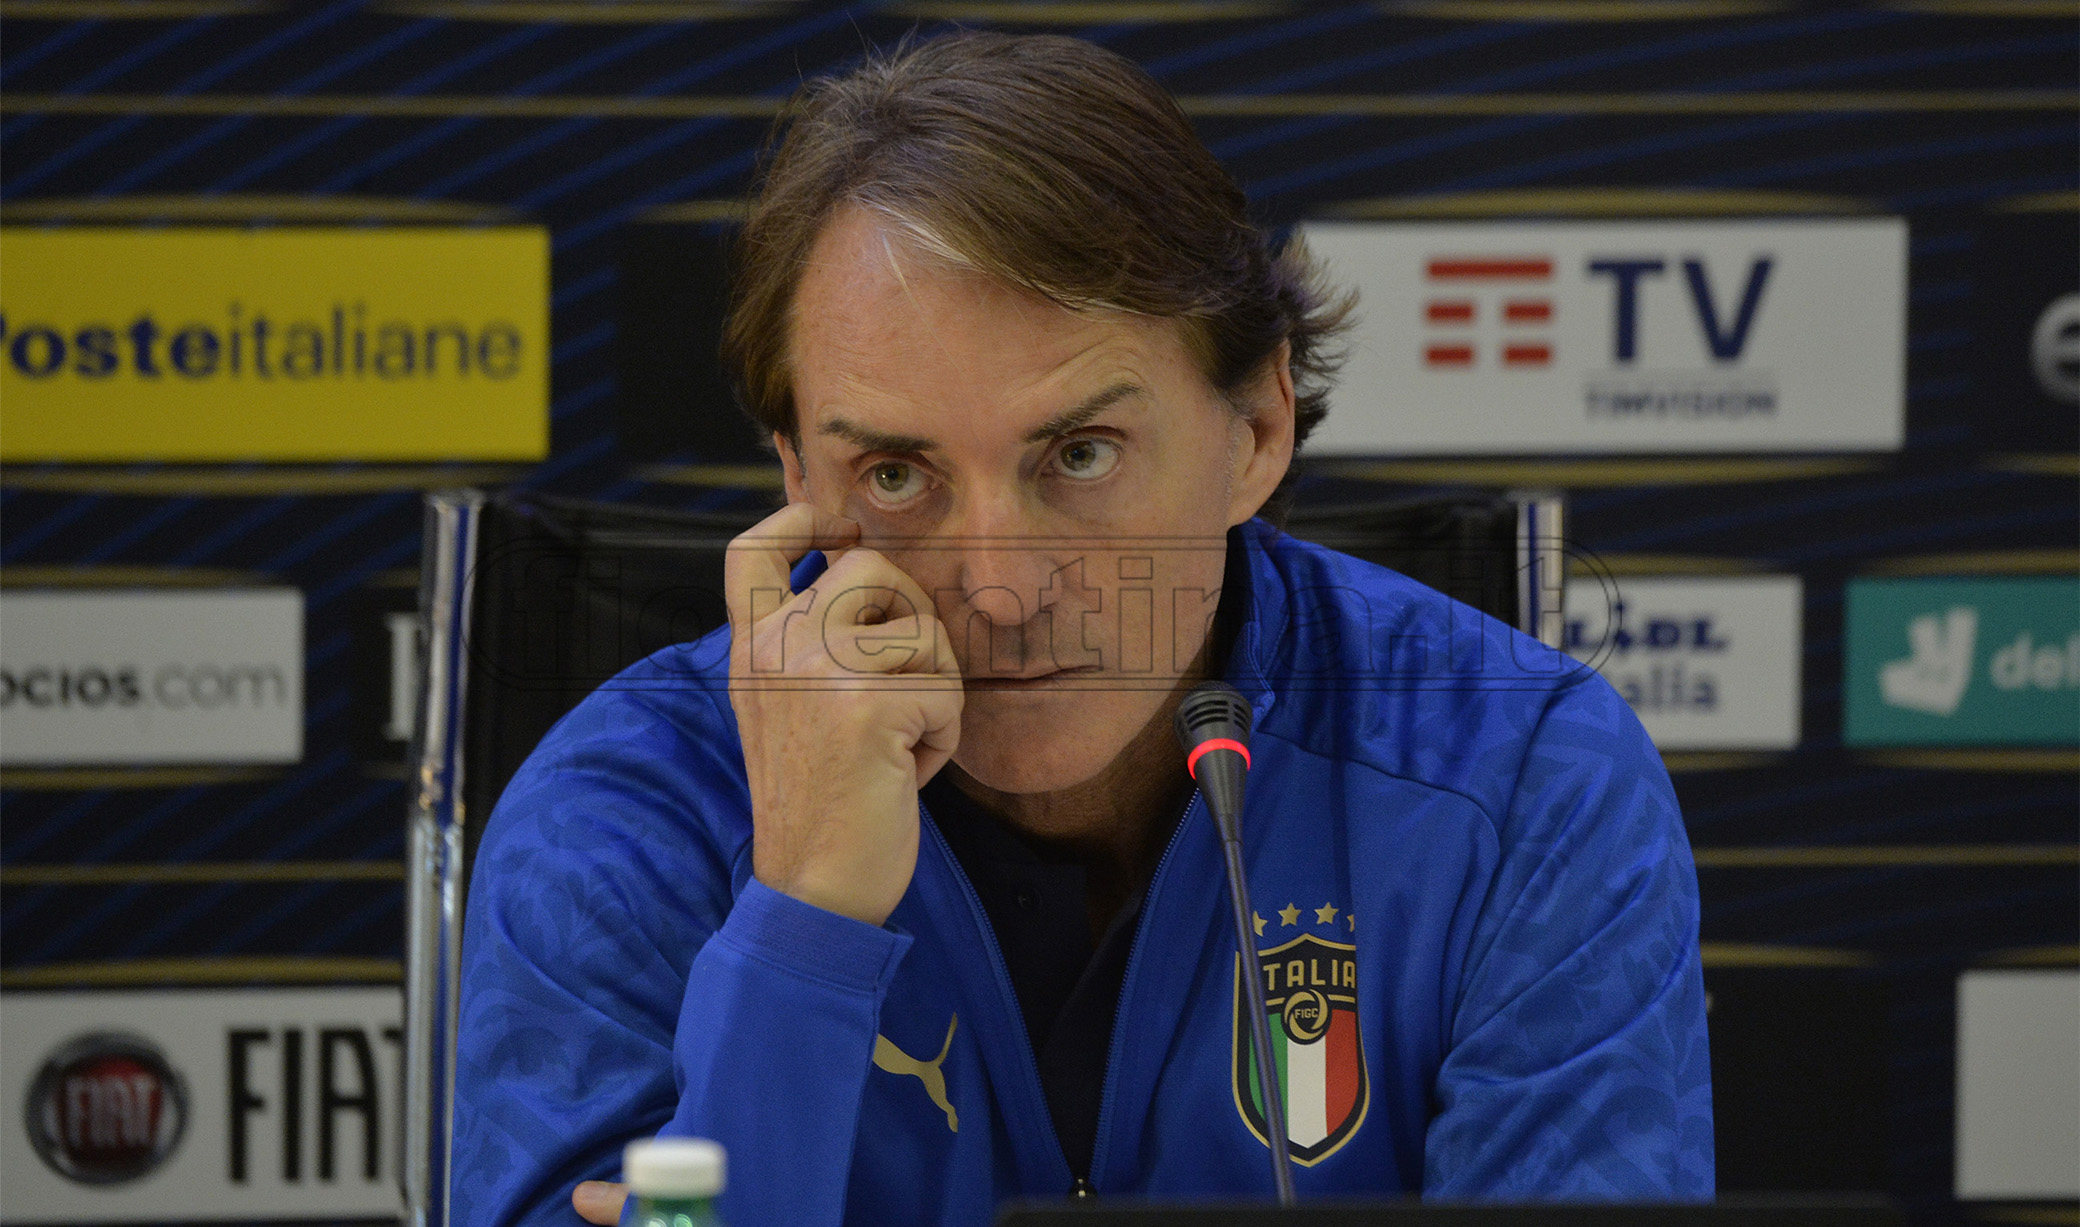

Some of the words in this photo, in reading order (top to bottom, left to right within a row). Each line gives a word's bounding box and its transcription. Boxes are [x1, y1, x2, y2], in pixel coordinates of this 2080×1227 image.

[1588, 258, 1776, 363] TV
[0, 302, 522, 380] osteitaliane
[1622, 664, 1719, 711] alia
[1262, 957, 1356, 991] TALIA
[1294, 1007, 1319, 1019] FIGC
